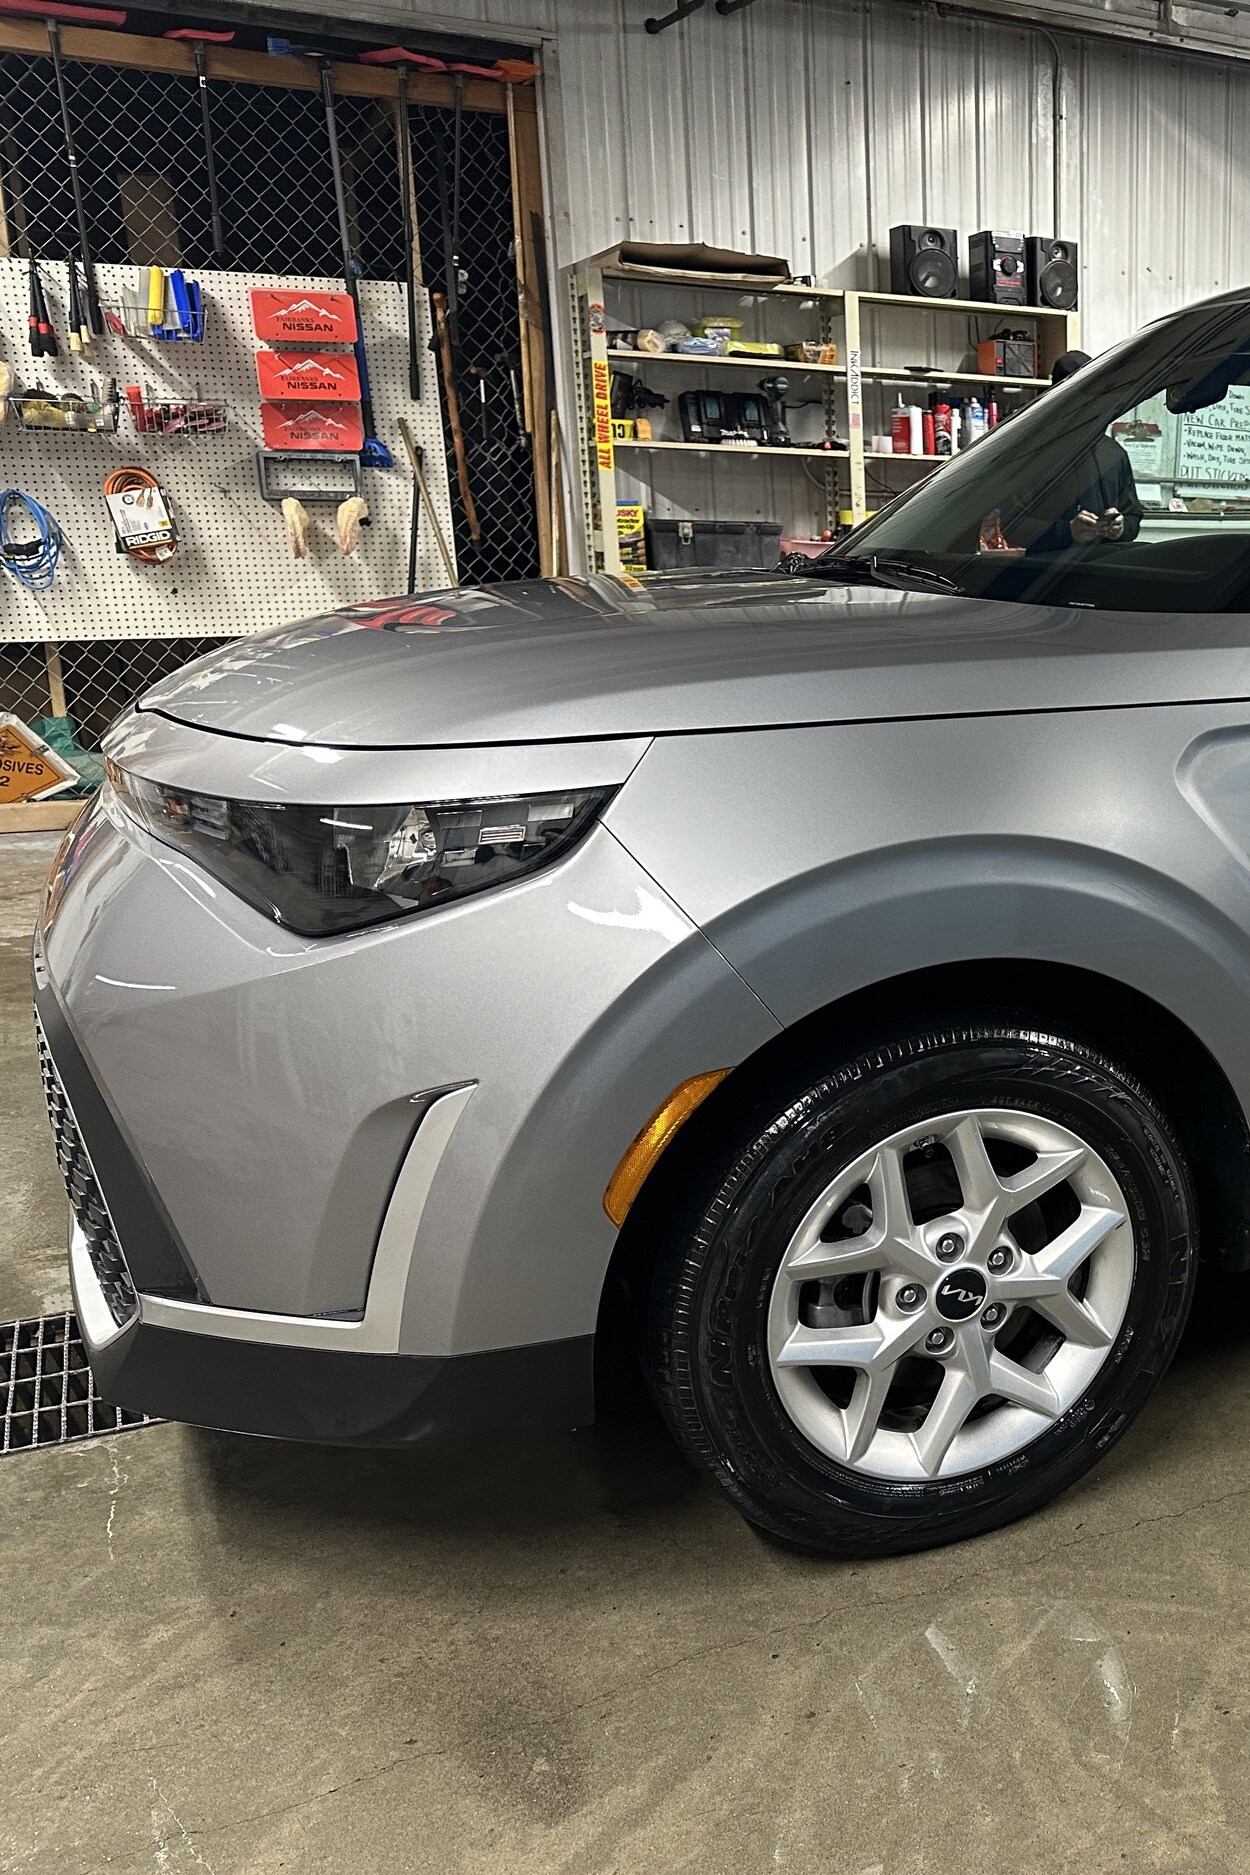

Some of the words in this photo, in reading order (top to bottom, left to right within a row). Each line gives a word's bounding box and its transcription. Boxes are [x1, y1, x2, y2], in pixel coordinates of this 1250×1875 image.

[282, 322, 334, 332] NISSAN
[287, 381, 337, 390] NISSAN
[594, 362, 608, 400] DRIVE
[596, 403, 611, 444] WHEEL
[290, 431, 340, 440] NISSAN
[599, 447, 612, 469] ALL
[125, 531, 171, 546] RIDGID
